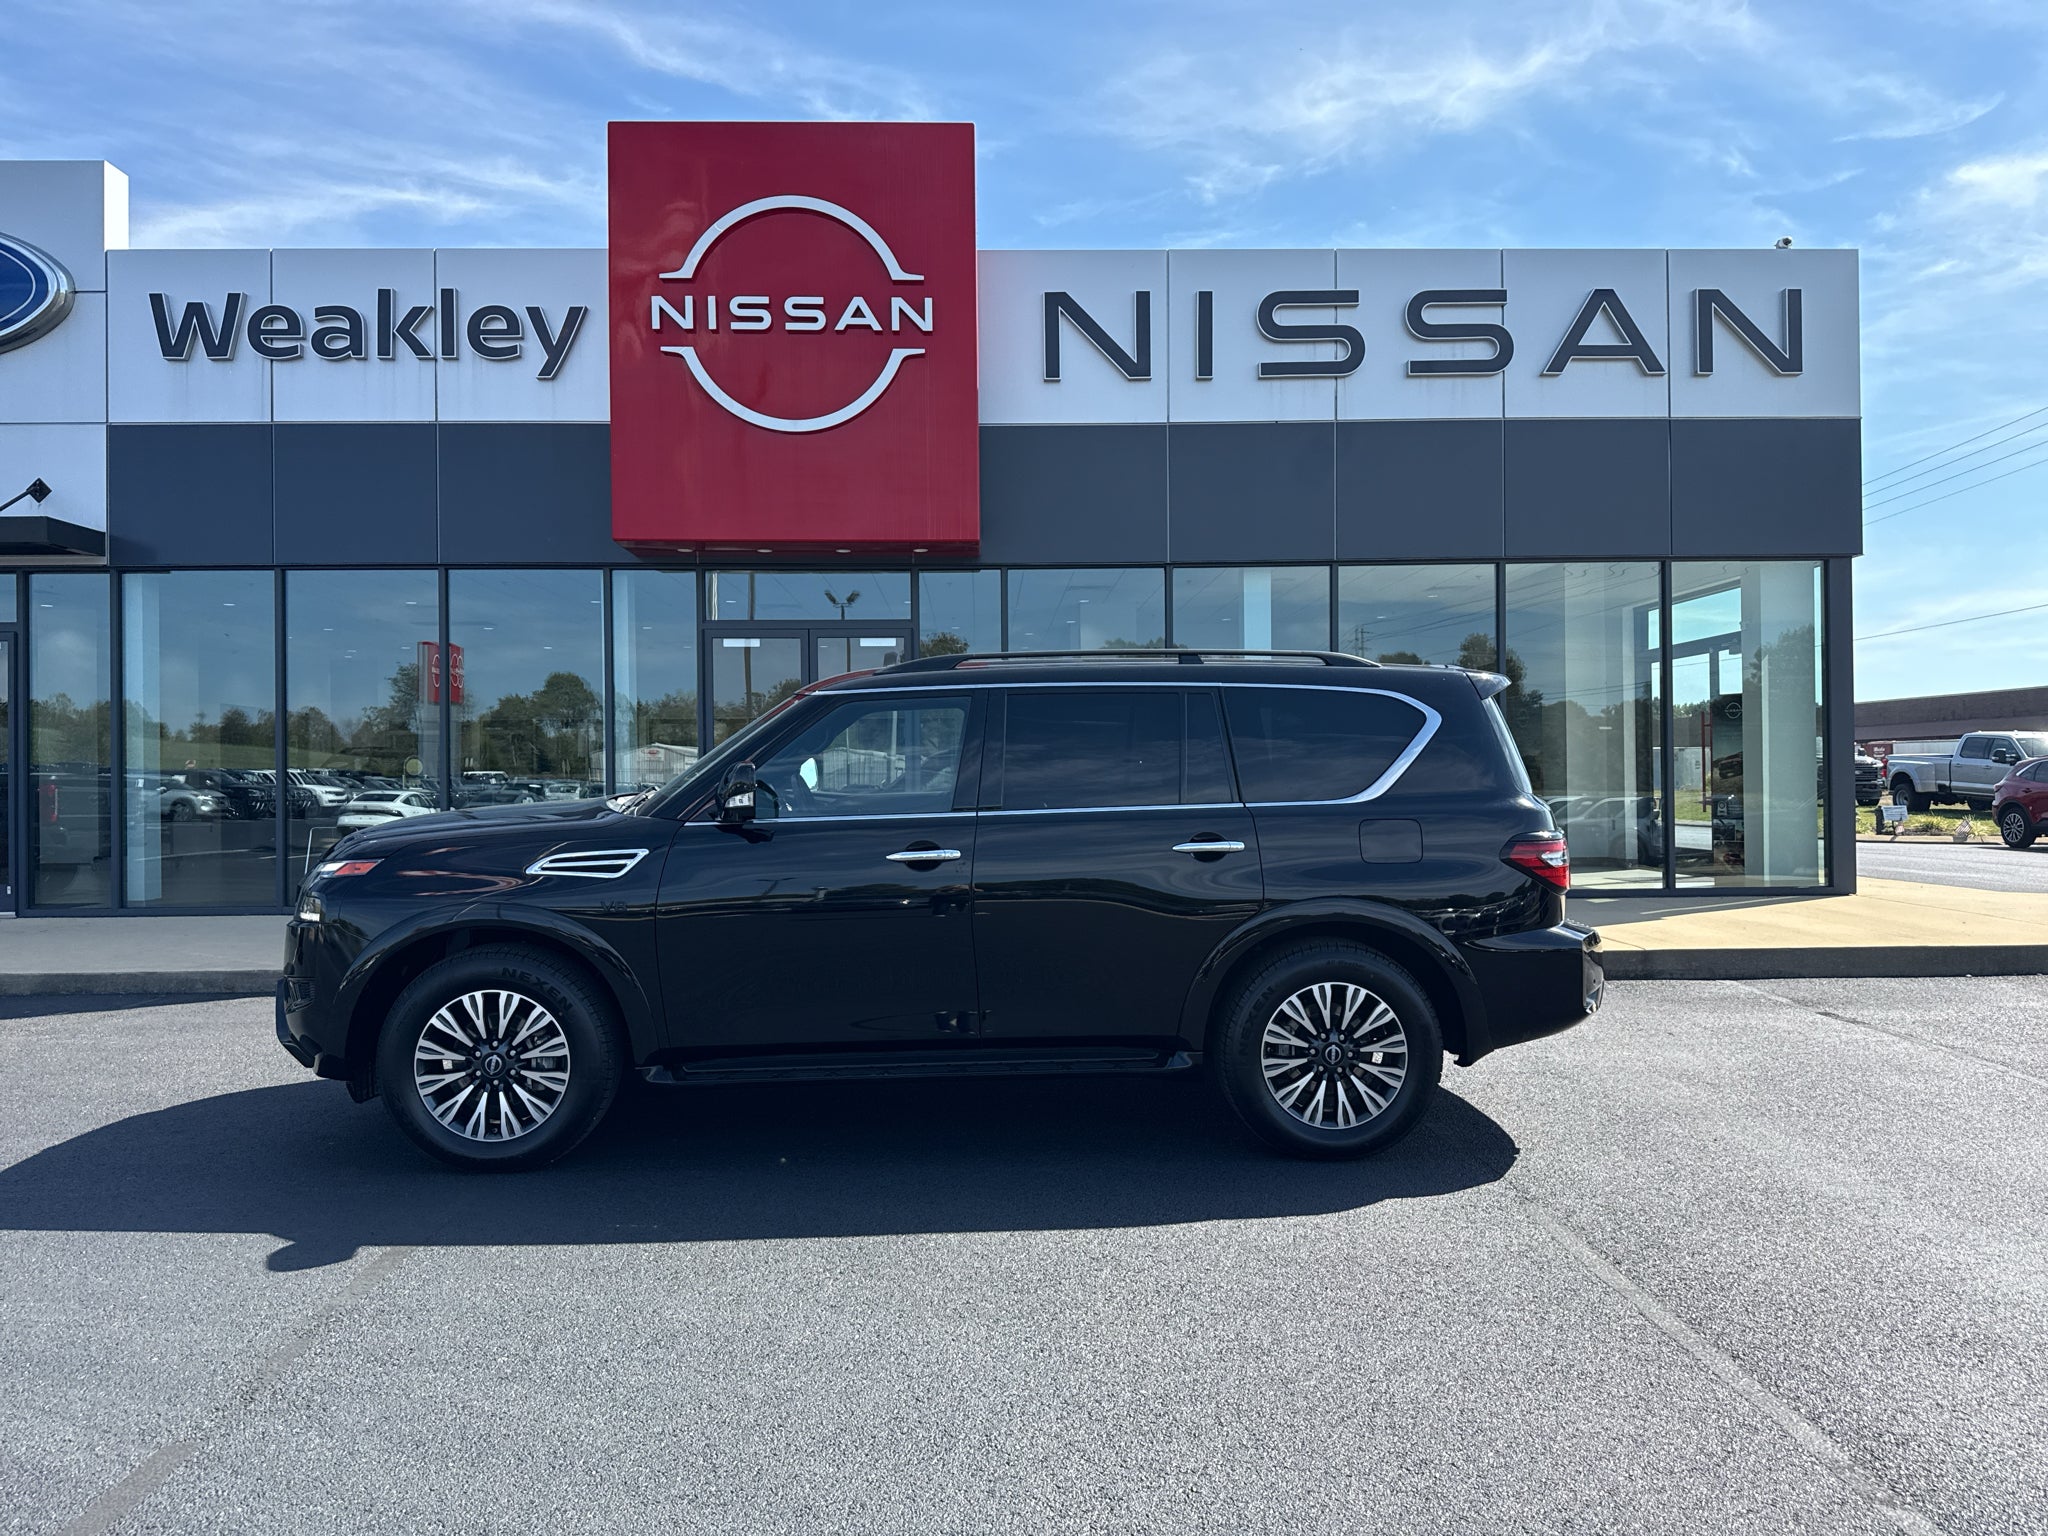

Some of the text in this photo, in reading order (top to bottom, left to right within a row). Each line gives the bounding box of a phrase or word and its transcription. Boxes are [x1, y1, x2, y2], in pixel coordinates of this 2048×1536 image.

[148, 287, 588, 381] Weakley
[651, 295, 934, 332] NISSAN
[1043, 288, 1804, 382] NISSAN
[600, 900, 627, 913] V8
[501, 967, 574, 1011] NEXEN
[1238, 985, 1274, 1057] NEXEN
